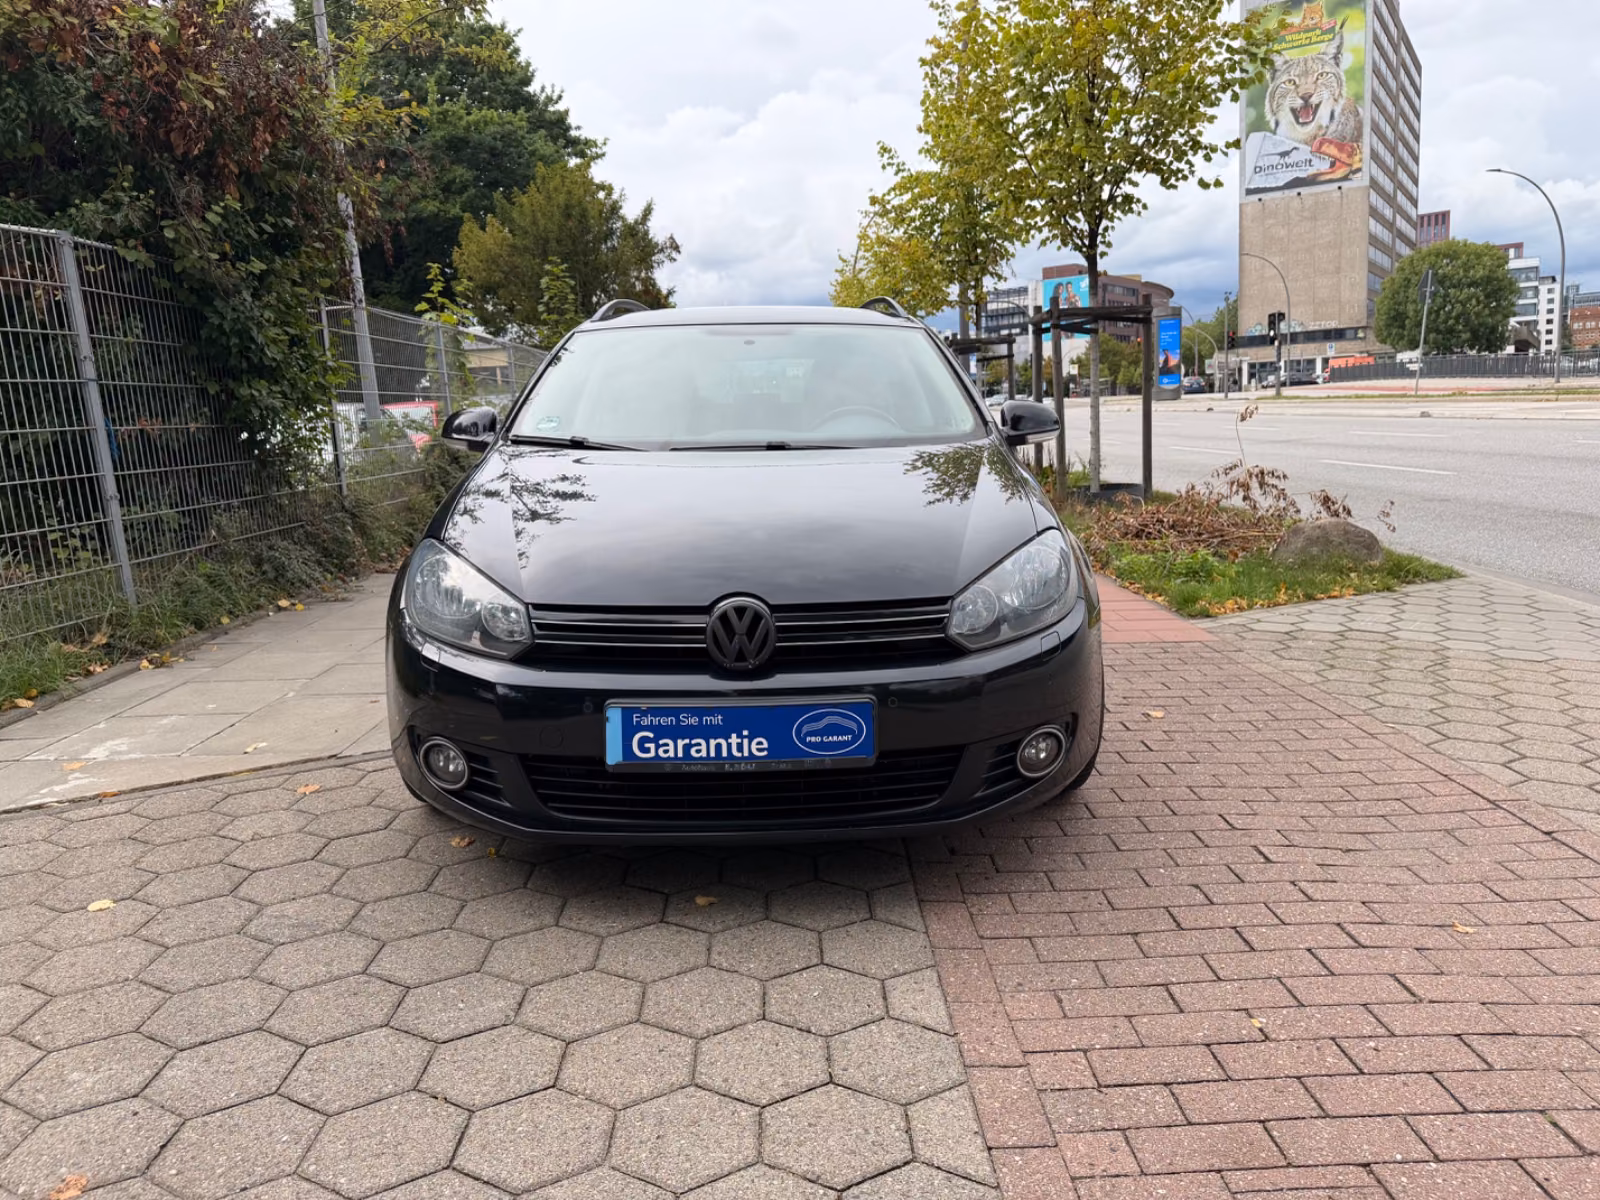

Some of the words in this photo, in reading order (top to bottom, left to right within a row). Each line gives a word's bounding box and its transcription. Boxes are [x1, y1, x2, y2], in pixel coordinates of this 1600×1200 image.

[1254, 158, 1314, 174] Dinowelt
[632, 713, 676, 726] Fahren
[679, 713, 699, 726] Sie
[702, 713, 723, 725] mit
[632, 729, 769, 758] Garantie
[823, 734, 852, 742] GARANT
